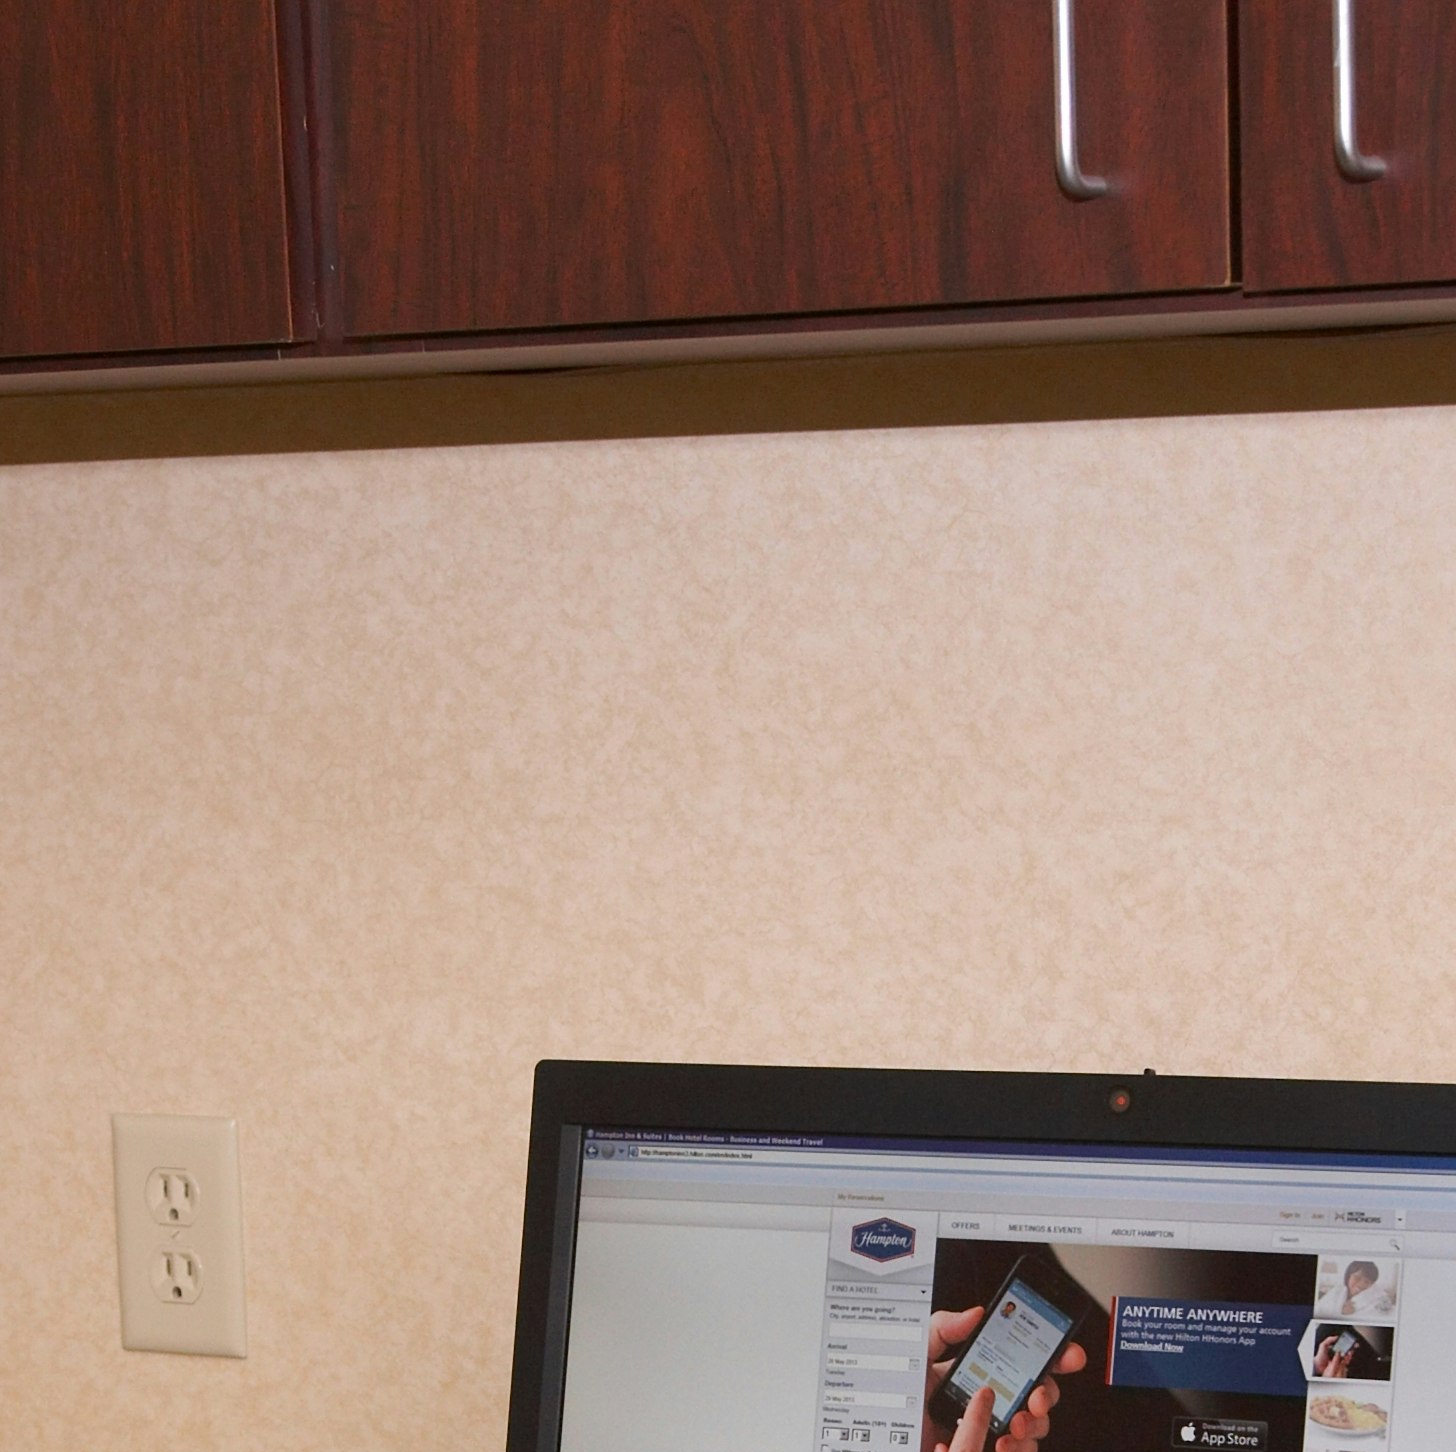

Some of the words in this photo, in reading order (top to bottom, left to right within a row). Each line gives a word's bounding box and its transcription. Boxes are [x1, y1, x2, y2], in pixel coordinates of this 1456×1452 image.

[668, 1133, 684, 1141] Book
[802, 1138, 824, 1146] Travel
[951, 1221, 980, 1230] OFFERS
[1008, 1224, 1045, 1232] MEETINGS
[1053, 1226, 1082, 1234] EVENTS
[855, 1230, 912, 1248] Hampton
[1111, 1228, 1136, 1237] ABOUT
[1138, 1230, 1174, 1238] HAMPTON
[832, 1285, 848, 1293] FIND
[855, 1286, 879, 1294] HOTEL
[1122, 1305, 1185, 1320] ANYTIME
[1186, 1308, 1264, 1324] ANYWHERE
[1121, 1319, 1143, 1328] Book
[1144, 1321, 1163, 1331] your
[1164, 1322, 1185, 1330] room
[1187, 1321, 1203, 1331] and
[1204, 1324, 1237, 1335] manage
[1238, 1325, 1257, 1336] your
[1259, 1327, 1292, 1336] account
[1120, 1330, 1140, 1339] with
[1141, 1331, 1154, 1340] the
[1155, 1333, 1174, 1341] new
[1175, 1332, 1200, 1342] Hilton
[1202, 1334, 1237, 1345] HHonors
[1238, 1336, 1256, 1347] App
[1120, 1340, 1163, 1352] Download
[1164, 1343, 1184, 1353] Now
[1200, 1431, 1226, 1446] App
[1227, 1432, 1259, 1446] Store
